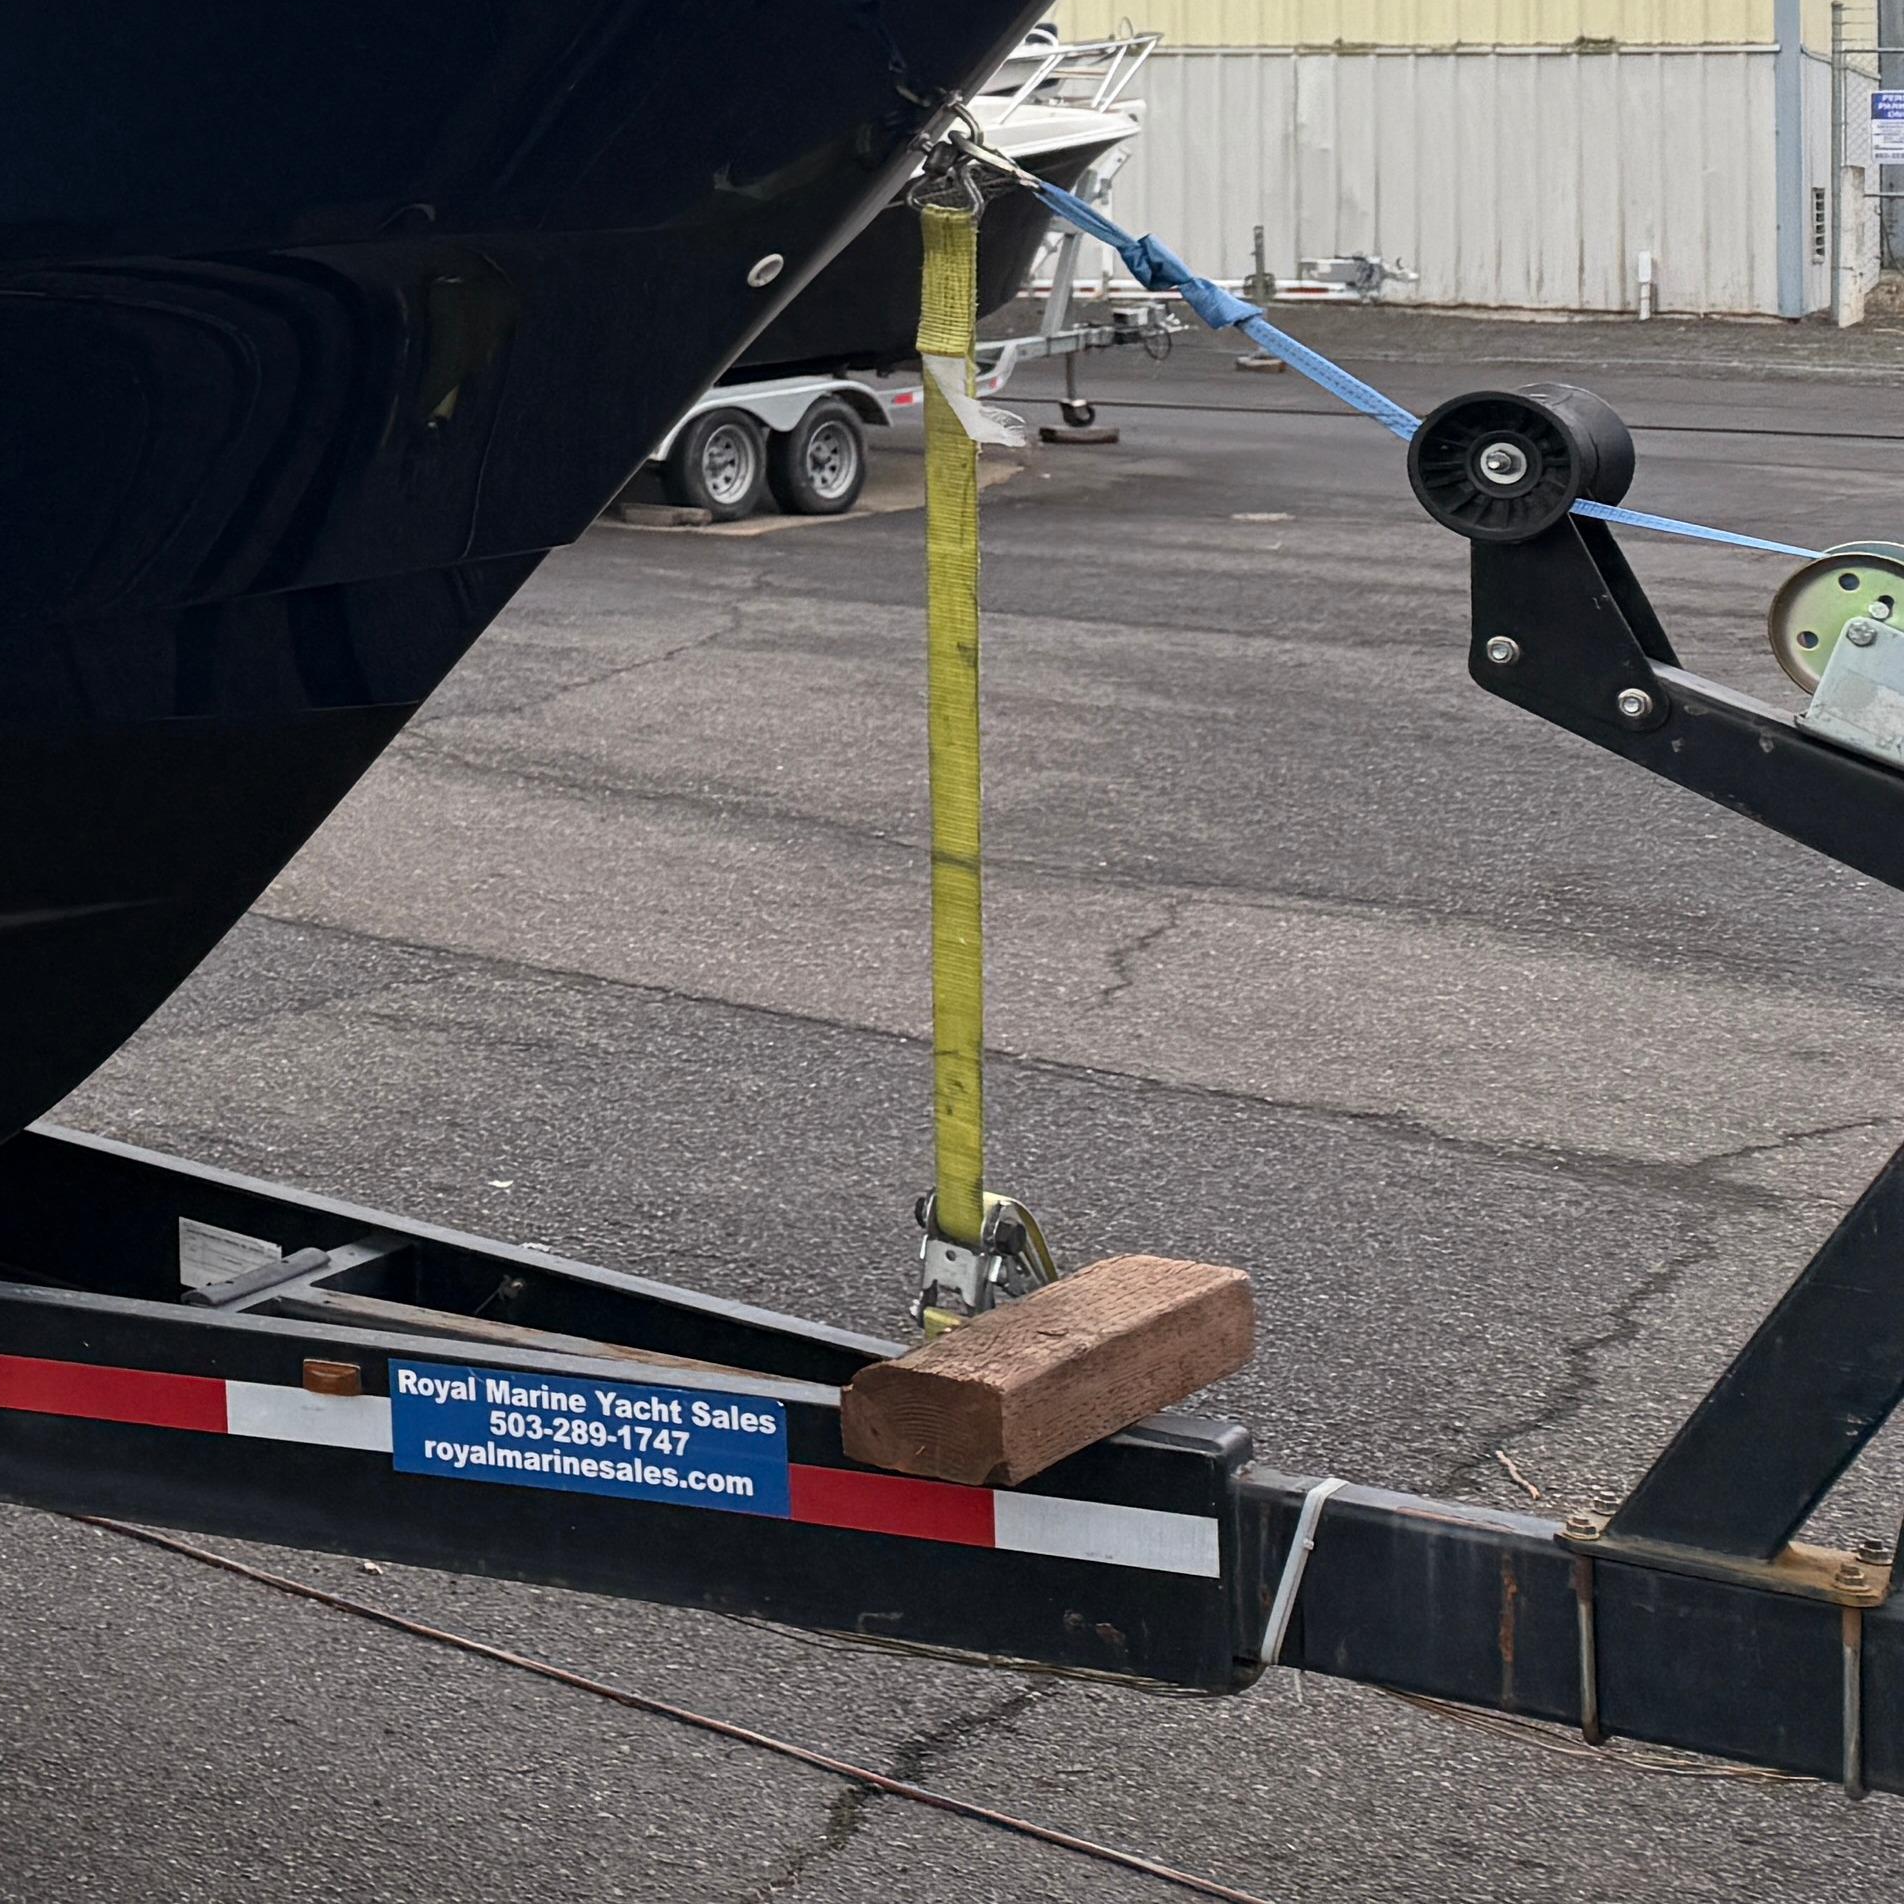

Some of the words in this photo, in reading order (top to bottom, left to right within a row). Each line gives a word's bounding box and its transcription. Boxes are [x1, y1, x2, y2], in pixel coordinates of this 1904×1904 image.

[398, 1368, 477, 1405] Royal
[485, 1377, 587, 1415] Marine
[594, 1390, 683, 1425] Yacht
[691, 1401, 778, 1435] Sales
[489, 1409, 691, 1457] 503-289-1747
[424, 1439, 755, 1497] royalmarinesales.com
